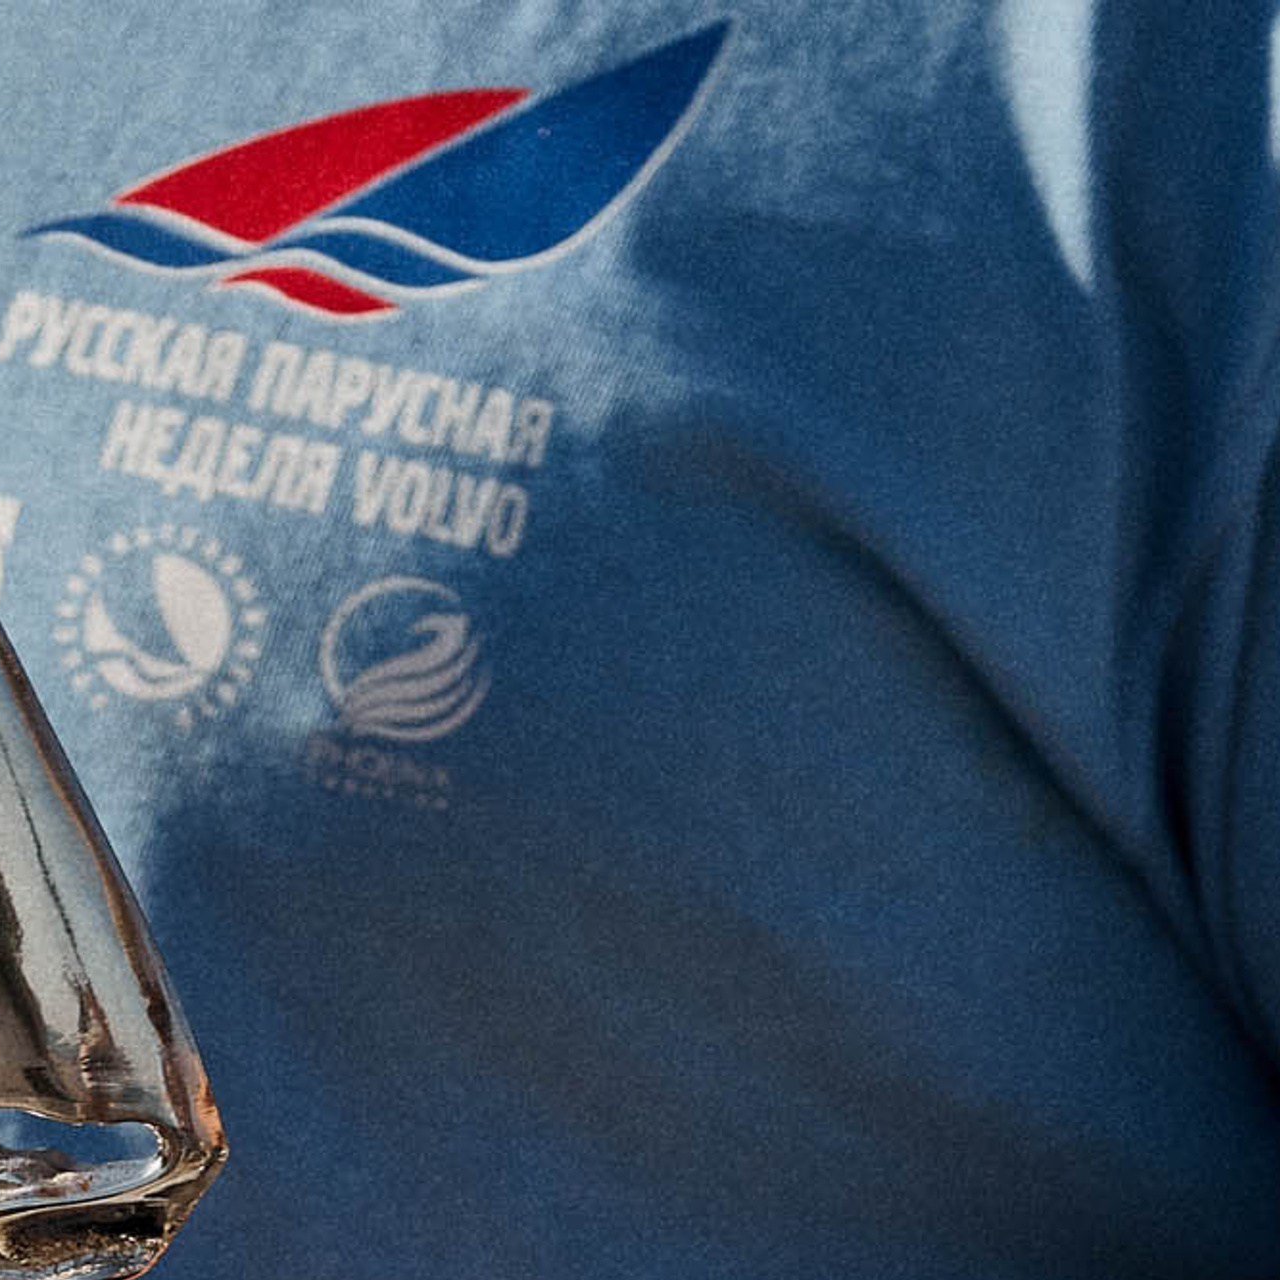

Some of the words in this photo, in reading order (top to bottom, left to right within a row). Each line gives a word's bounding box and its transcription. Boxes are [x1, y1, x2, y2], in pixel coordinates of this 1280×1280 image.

[246, 339, 554, 469] ПАРУСНАЯ
[99, 399, 342, 515] НЕДЕЛЯ
[353, 449, 529, 559] VOLVO
